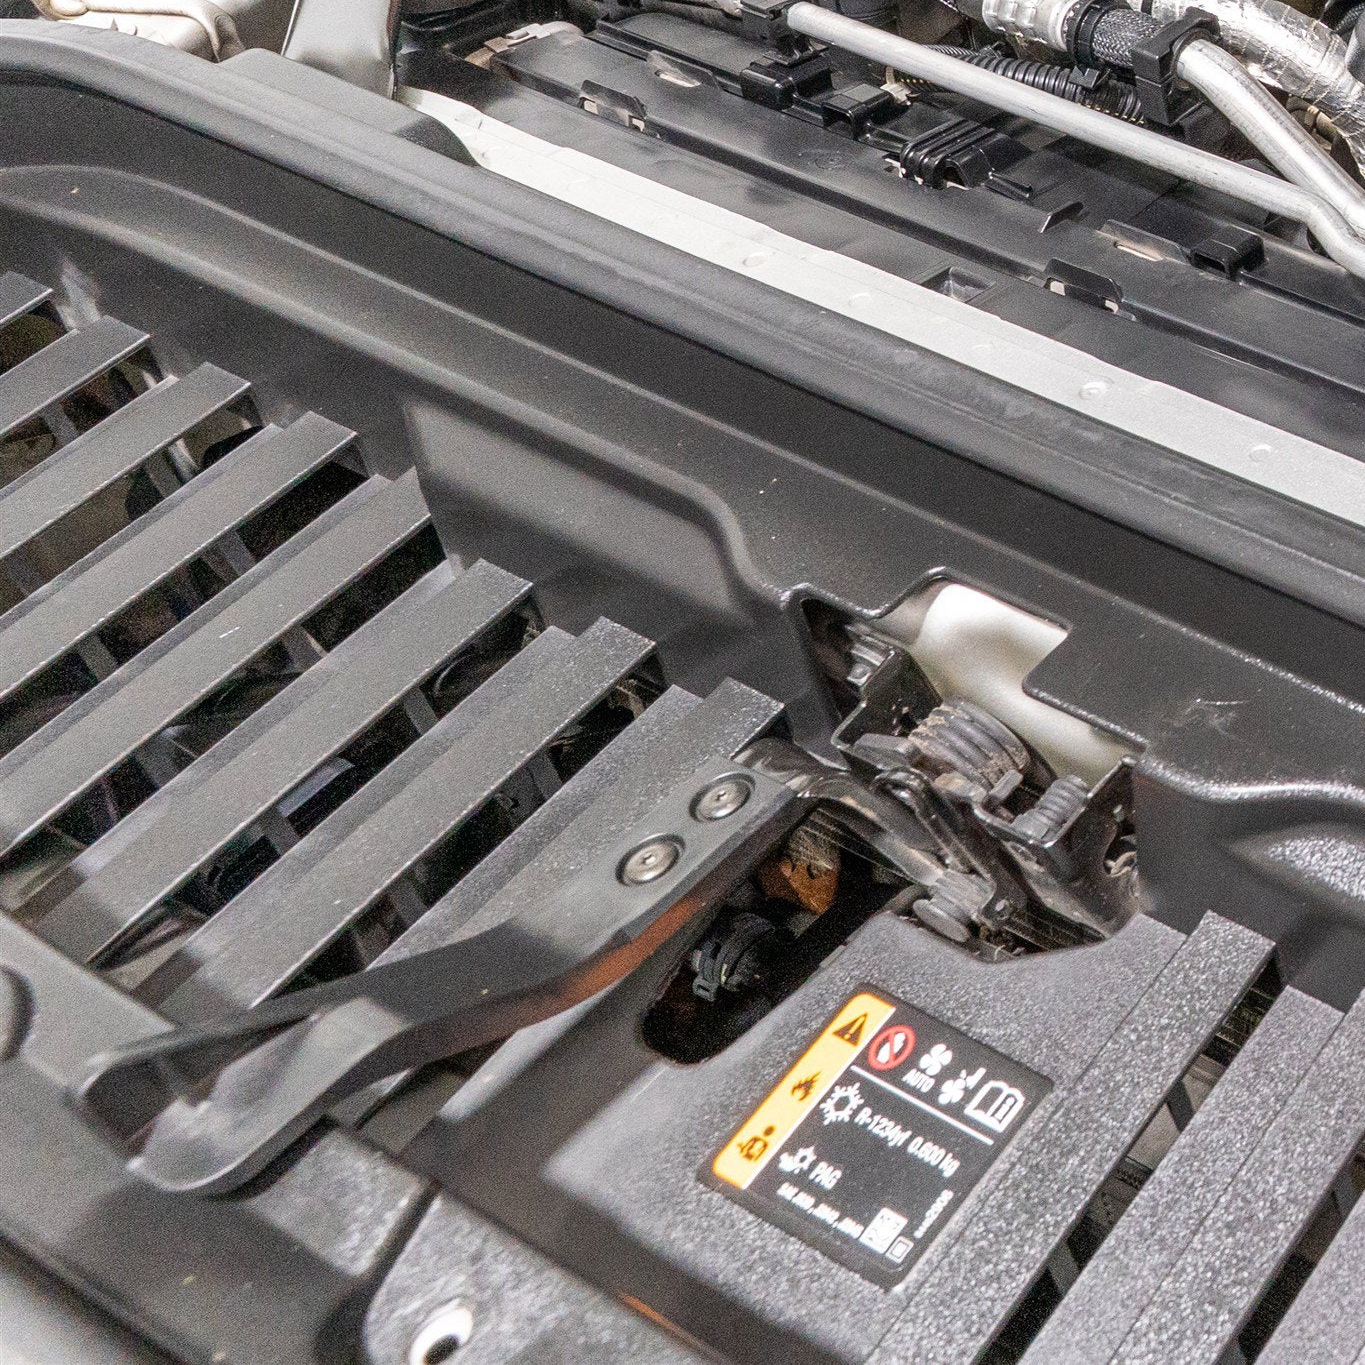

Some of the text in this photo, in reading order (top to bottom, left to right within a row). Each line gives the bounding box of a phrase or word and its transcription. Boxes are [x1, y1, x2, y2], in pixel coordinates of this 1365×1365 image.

[902, 1067, 936, 1094] AUTO
[853, 1106, 961, 1178] R-1234yf 0.600 kg
[810, 1160, 843, 1190] PAG
